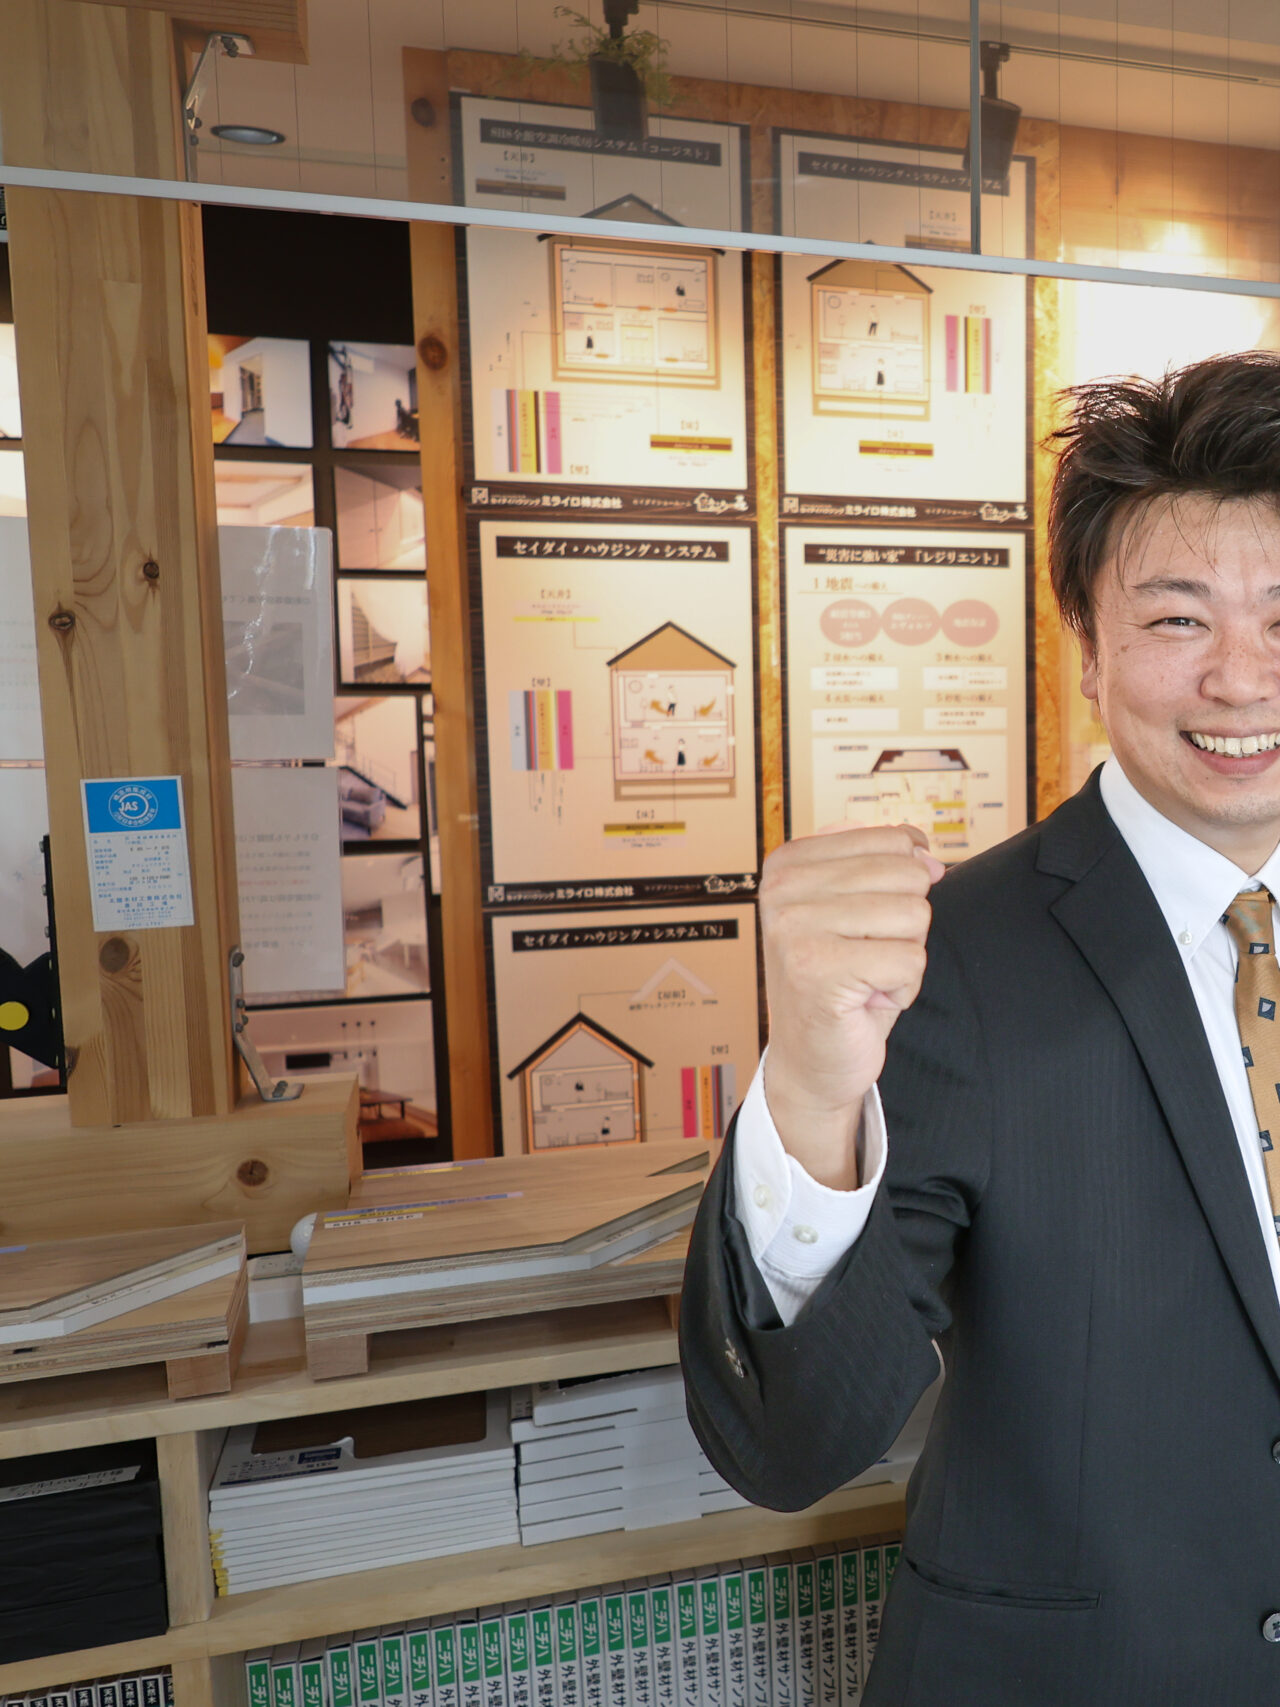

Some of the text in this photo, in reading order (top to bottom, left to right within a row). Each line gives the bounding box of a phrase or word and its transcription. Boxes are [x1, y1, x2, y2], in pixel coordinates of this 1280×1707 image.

[541, 495, 623, 509] ミライロ株式会社
[845, 504, 917, 518] ミライロ株式会社
[513, 540, 718, 559] セイダイ・ハウジング・システム
[118, 801, 139, 813] JAS
[556, 884, 634, 900] ミライロ株式会社
[776, 1577, 787, 1612] ニチハ
[800, 1574, 811, 1609] ニチハ
[821, 1569, 832, 1603] ニチハ
[844, 1564, 855, 1599] ニチハ
[867, 1560, 877, 1594] ニチハ
[656, 1599, 667, 1636] ニチハ
[681, 1594, 693, 1631] ニチハ
[705, 1591, 716, 1628] ニチハ
[729, 1586, 740, 1622] ニチハ
[751, 1581, 763, 1617] ニチハ
[536, 1620, 549, 1659] ニチハ
[561, 1617, 573, 1655] ニチハ
[584, 1611, 597, 1649] ニチハ
[609, 1606, 621, 1644] ニチハ
[632, 1604, 644, 1641] ニチハ
[413, 1643, 426, 1683] ニチハ
[439, 1639, 452, 1679] ニチハ
[464, 1636, 477, 1675] ニチハ
[486, 1631, 499, 1670] ニチハ
[512, 1625, 525, 1664] ニチハ
[334, 1660, 349, 1700] ニチハ
[361, 1653, 376, 1693] ニチハ
[386, 1648, 400, 1689] ニチハ
[125, 1684, 135, 1706] 天然木
[147, 1679, 156, 1705] 天然木
